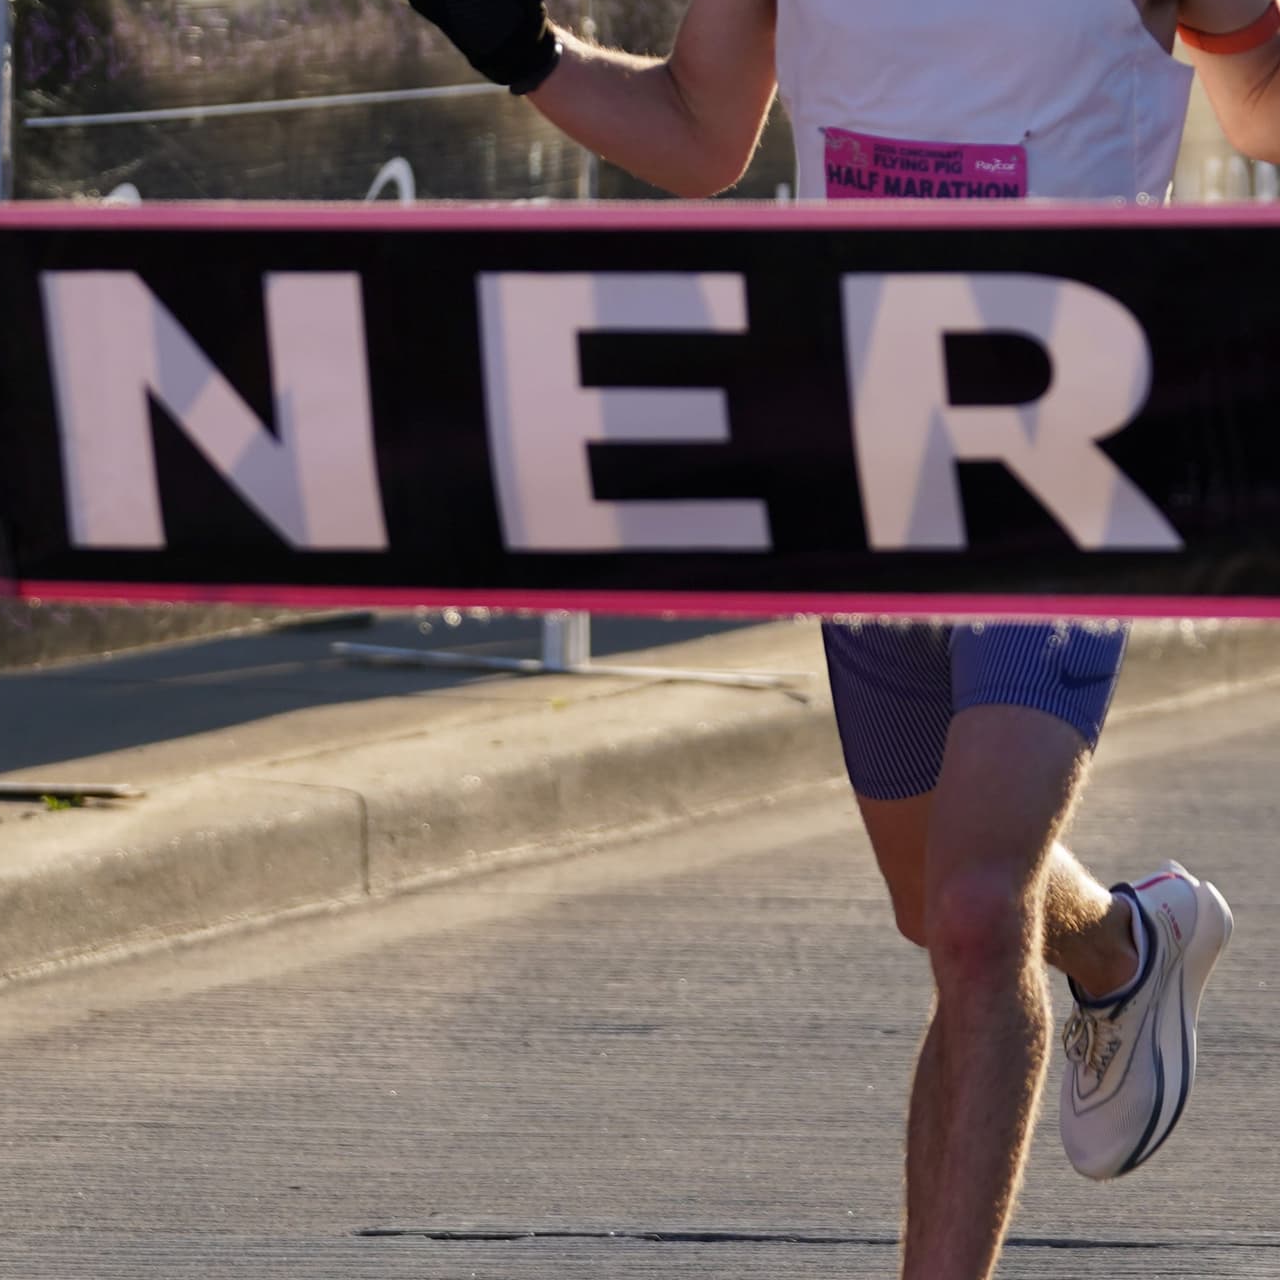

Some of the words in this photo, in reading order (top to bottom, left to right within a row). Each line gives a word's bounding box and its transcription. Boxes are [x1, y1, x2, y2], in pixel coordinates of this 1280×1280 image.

[873, 153, 929, 173] FLYING
[934, 159, 964, 174] PIG
[975, 158, 1017, 173] Paycor
[827, 163, 880, 192] HALF
[883, 175, 1020, 198] MARATHON
